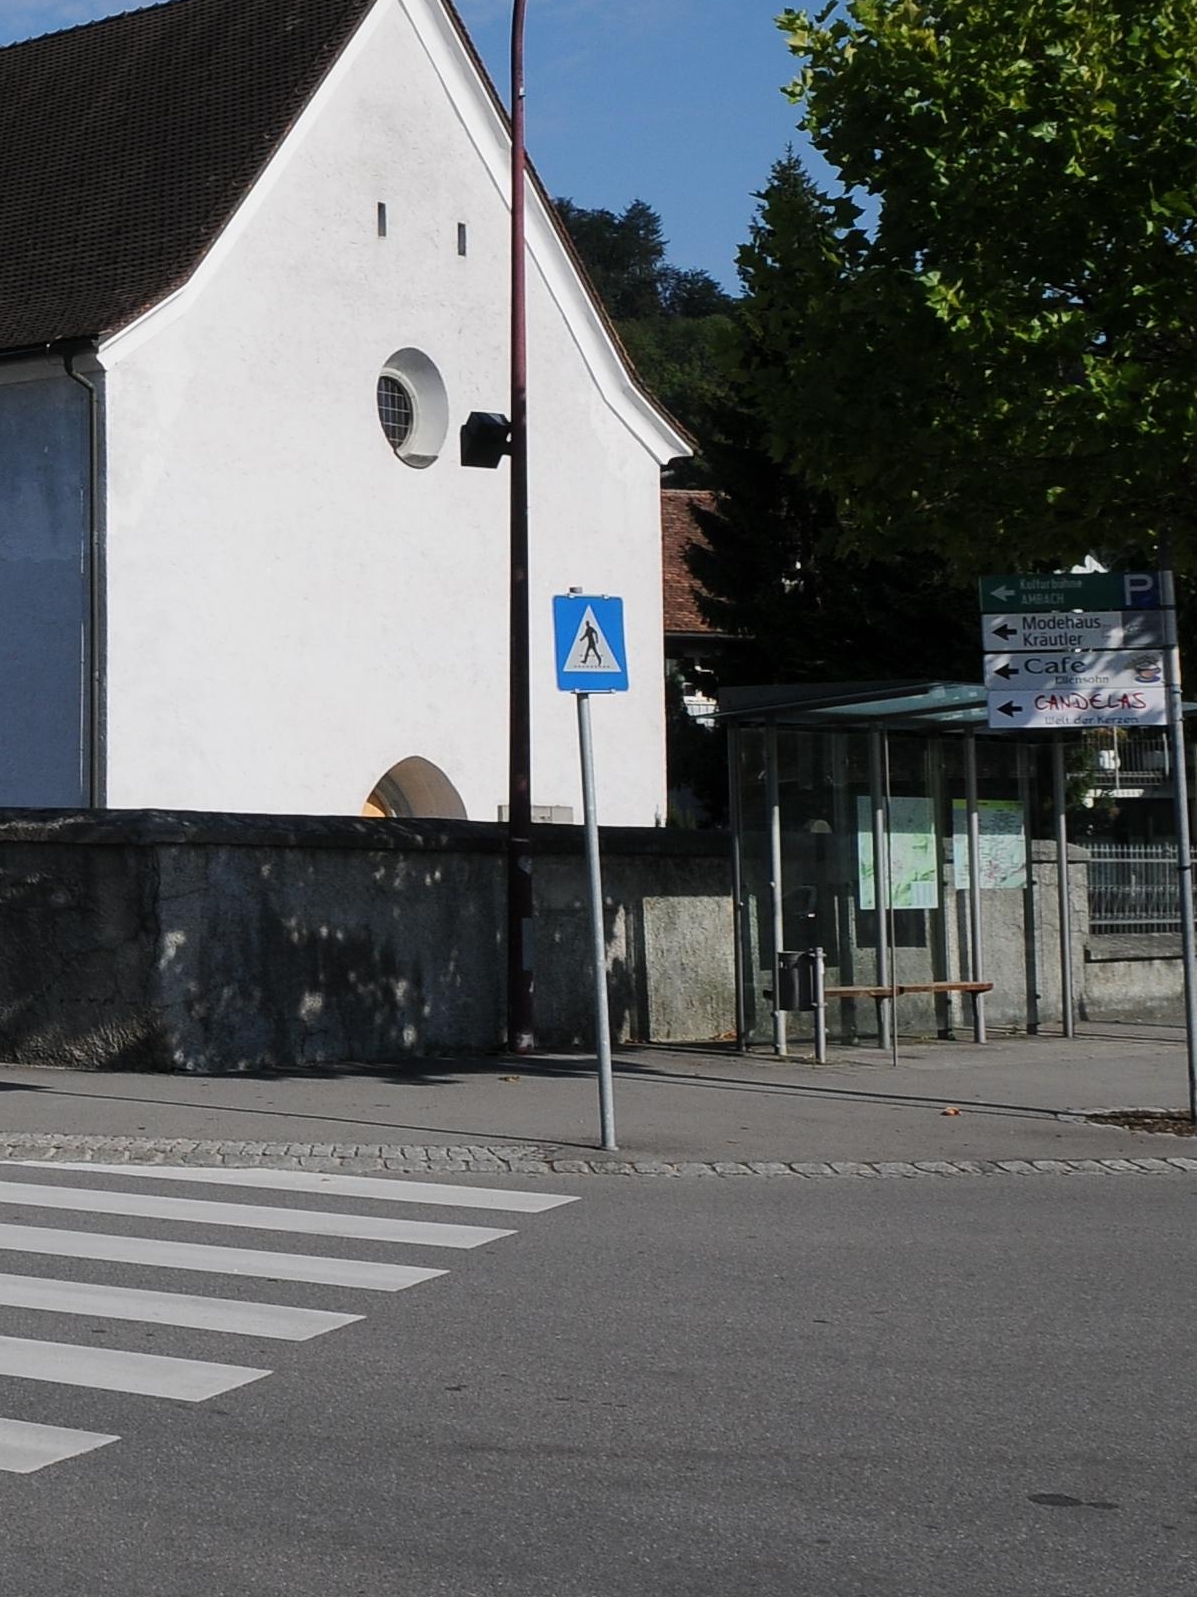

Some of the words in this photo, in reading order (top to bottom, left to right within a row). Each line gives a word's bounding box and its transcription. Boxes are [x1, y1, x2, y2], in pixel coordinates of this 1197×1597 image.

[1123, 573, 1154, 606] P
[1022, 616, 1101, 630] Modehaus
[1023, 632, 1084, 647] Kräutler
[1024, 657, 1087, 675] Cafe
[1034, 691, 1147, 711] CANDELAS
[1073, 715, 1095, 725] der
[1096, 715, 1139, 725] Kerzen
